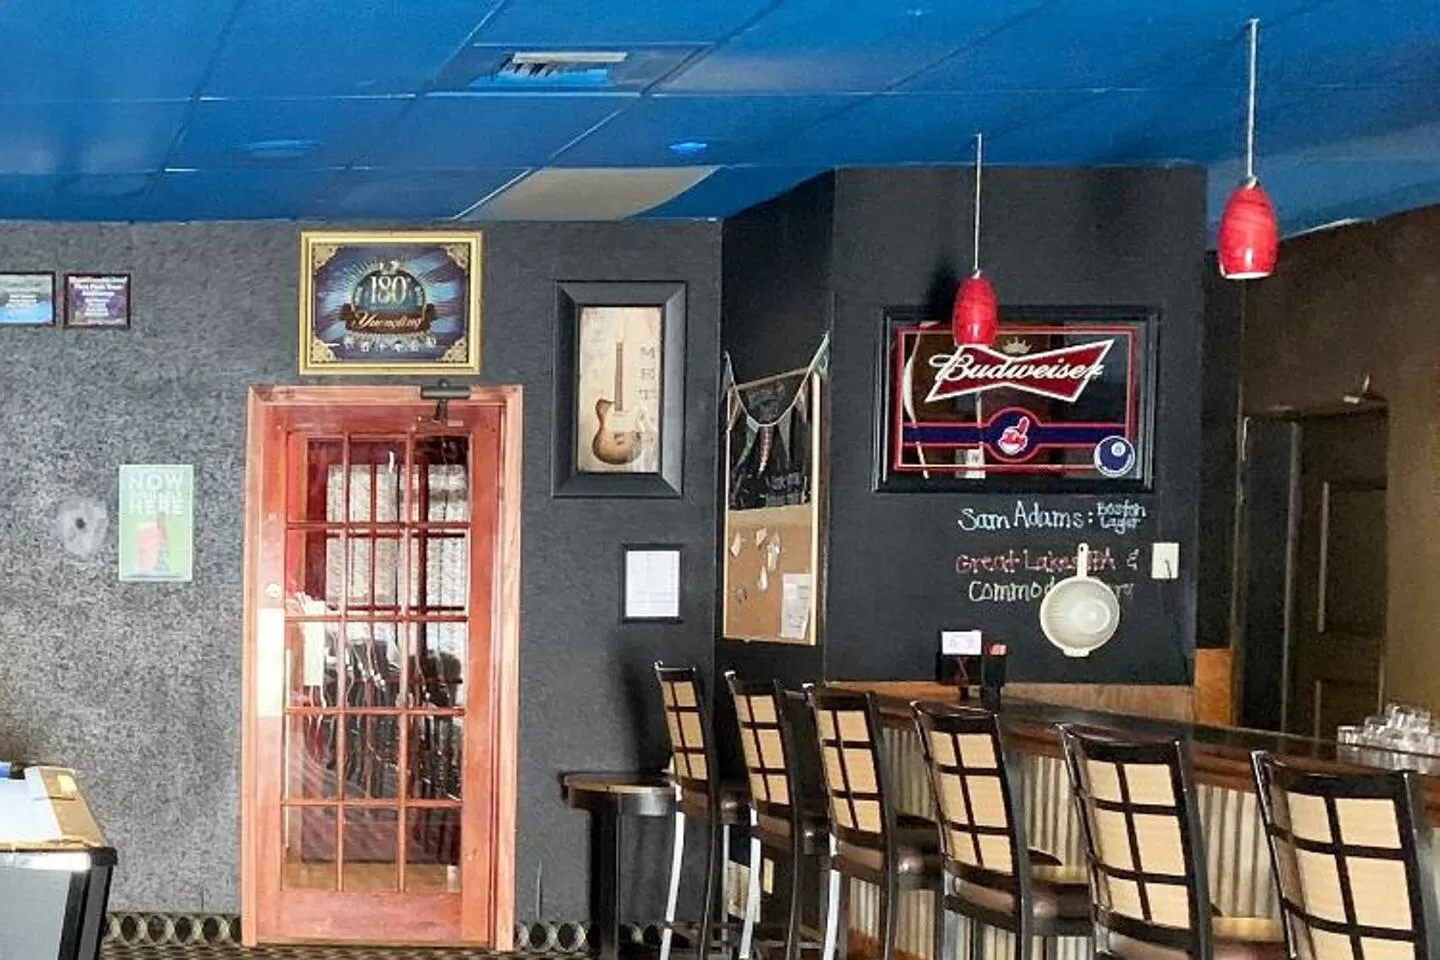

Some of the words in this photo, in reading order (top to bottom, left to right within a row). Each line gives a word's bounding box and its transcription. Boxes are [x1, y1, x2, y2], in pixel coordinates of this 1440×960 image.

[370, 275, 407, 304] 180
[929, 354, 1103, 382] Budweiser
[129, 471, 184, 491] NOW
[958, 508, 1010, 531] Sam
[1096, 499, 1147, 518] Boston
[1099, 515, 1142, 535] Lager
[956, 549, 1021, 574] Great
